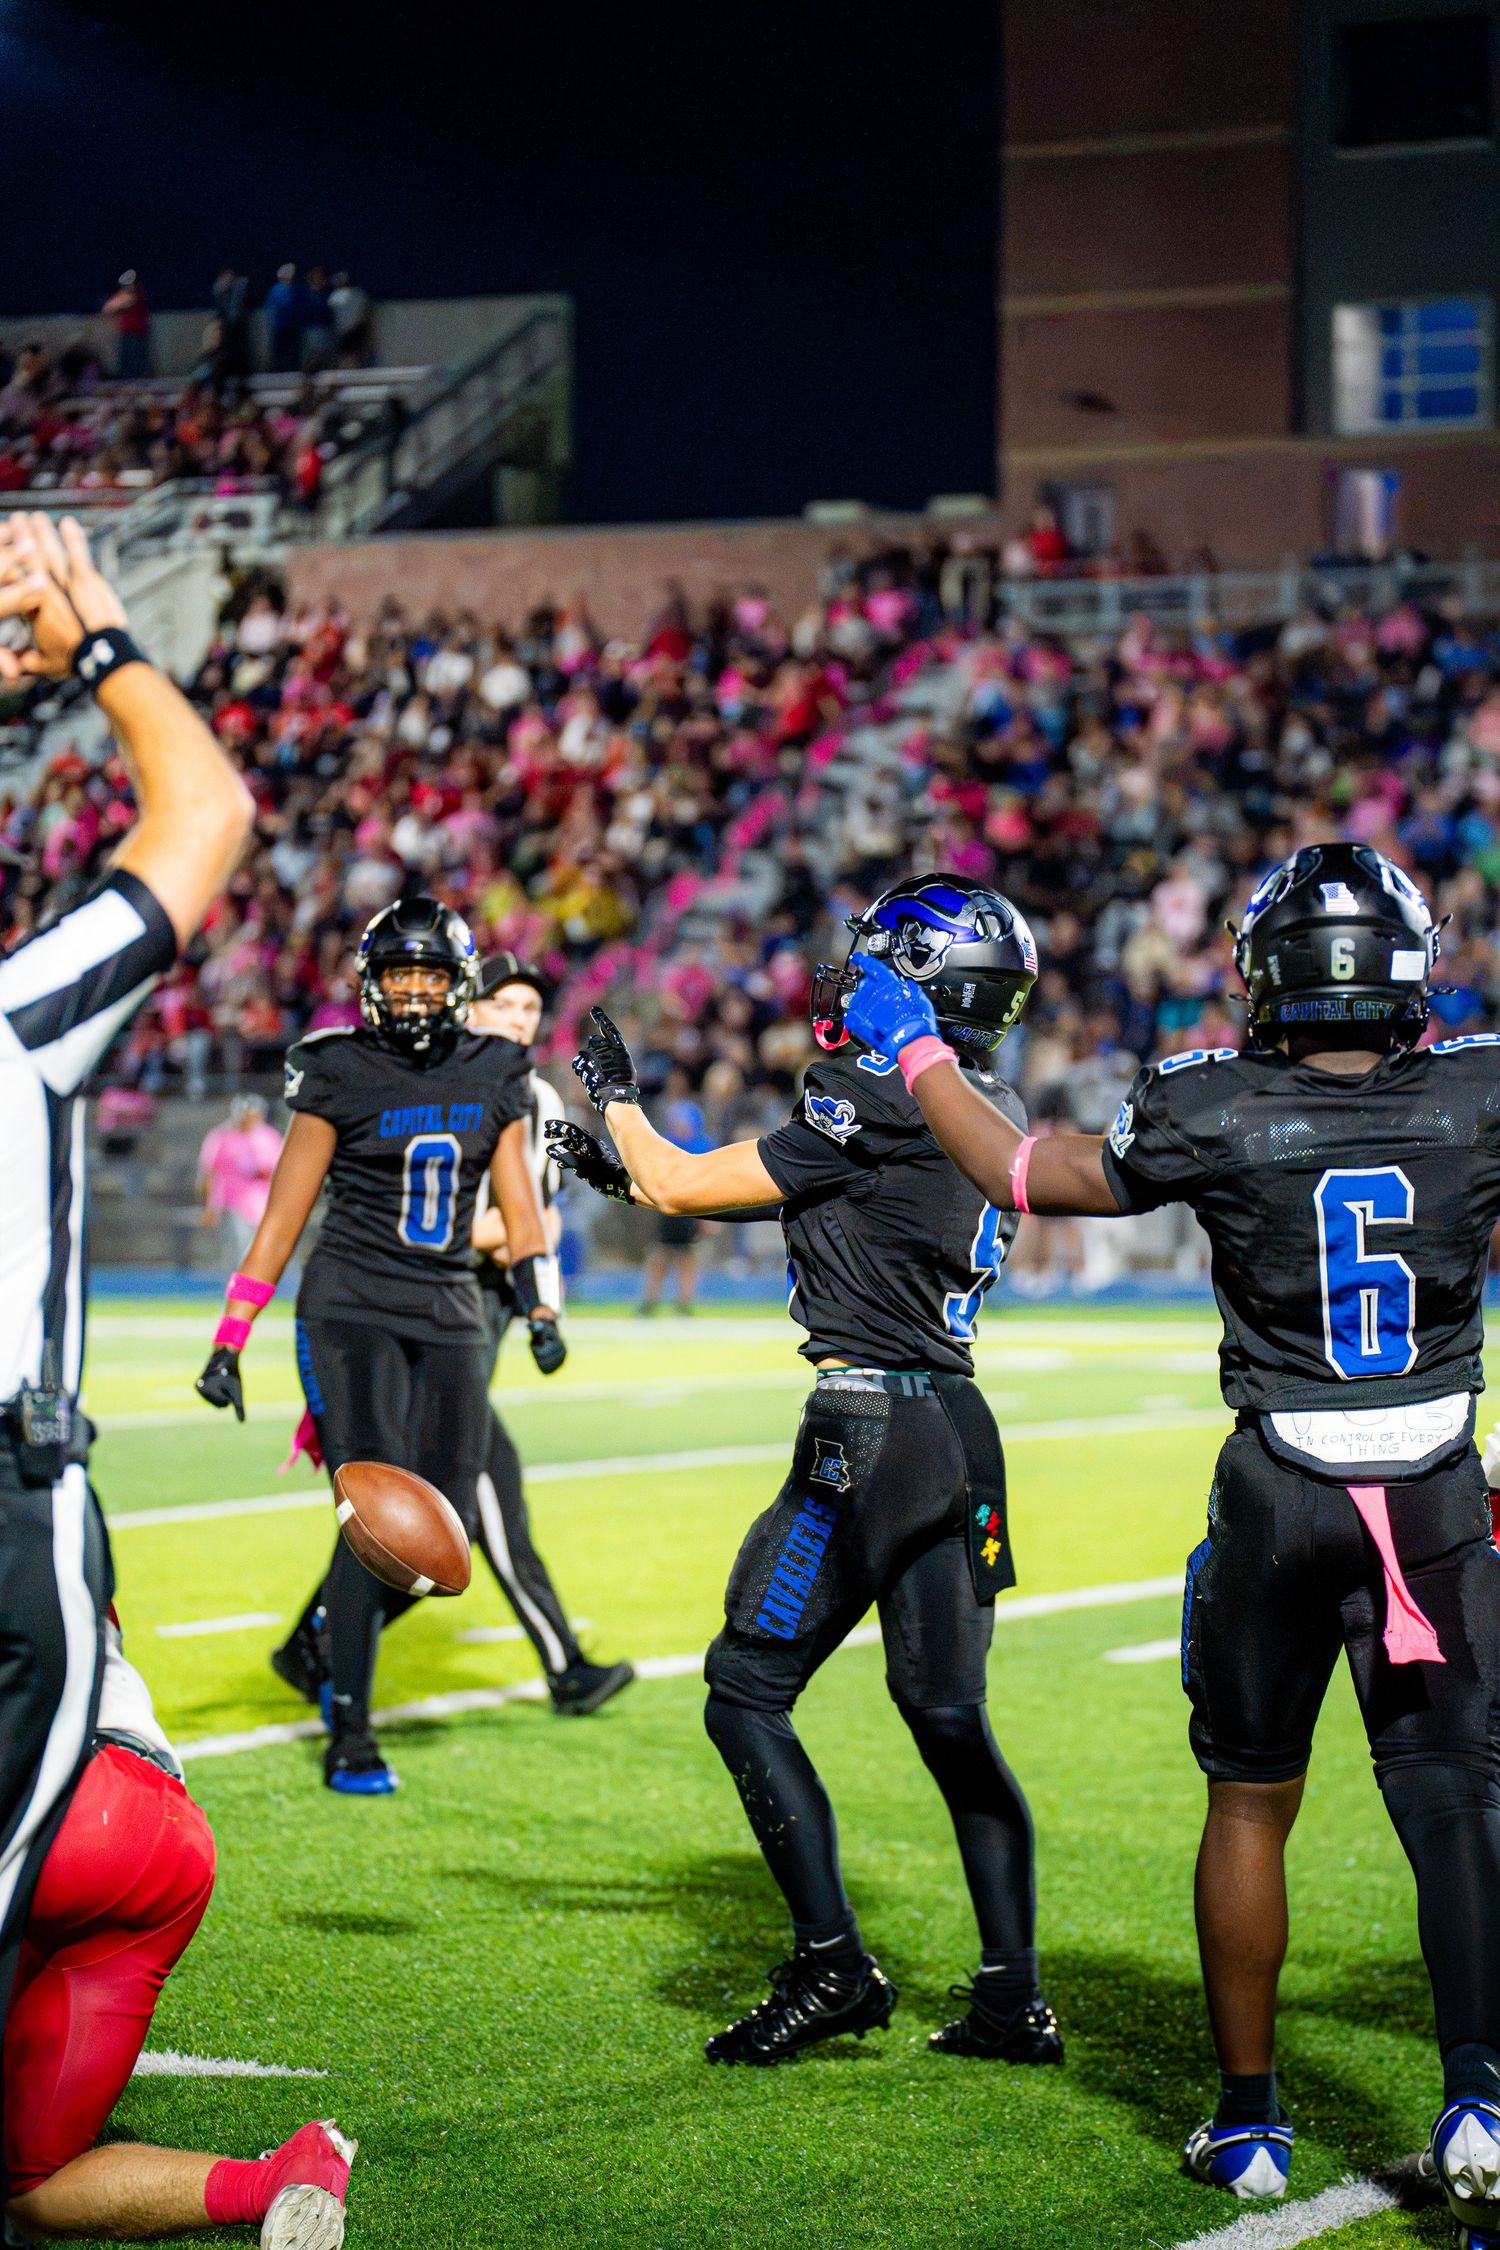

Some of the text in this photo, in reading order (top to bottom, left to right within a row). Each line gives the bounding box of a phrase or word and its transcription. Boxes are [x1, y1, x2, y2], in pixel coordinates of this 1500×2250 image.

[1330, 937, 1356, 981] 6
[1003, 991, 1026, 1023] 5
[1280, 1000, 1395, 1021] CAPITAL CITY
[379, 1103, 484, 1139] CAPITAL CITY
[397, 1133, 463, 1253] 0
[943, 1200, 1005, 1344] 5
[1313, 1165, 1420, 1382] 6
[1295, 1432, 1444, 1449] IN CONTROL OF EVERY
[1345, 1442, 1401, 1457] THING
[756, 1496, 838, 1640] CAVALIERS
